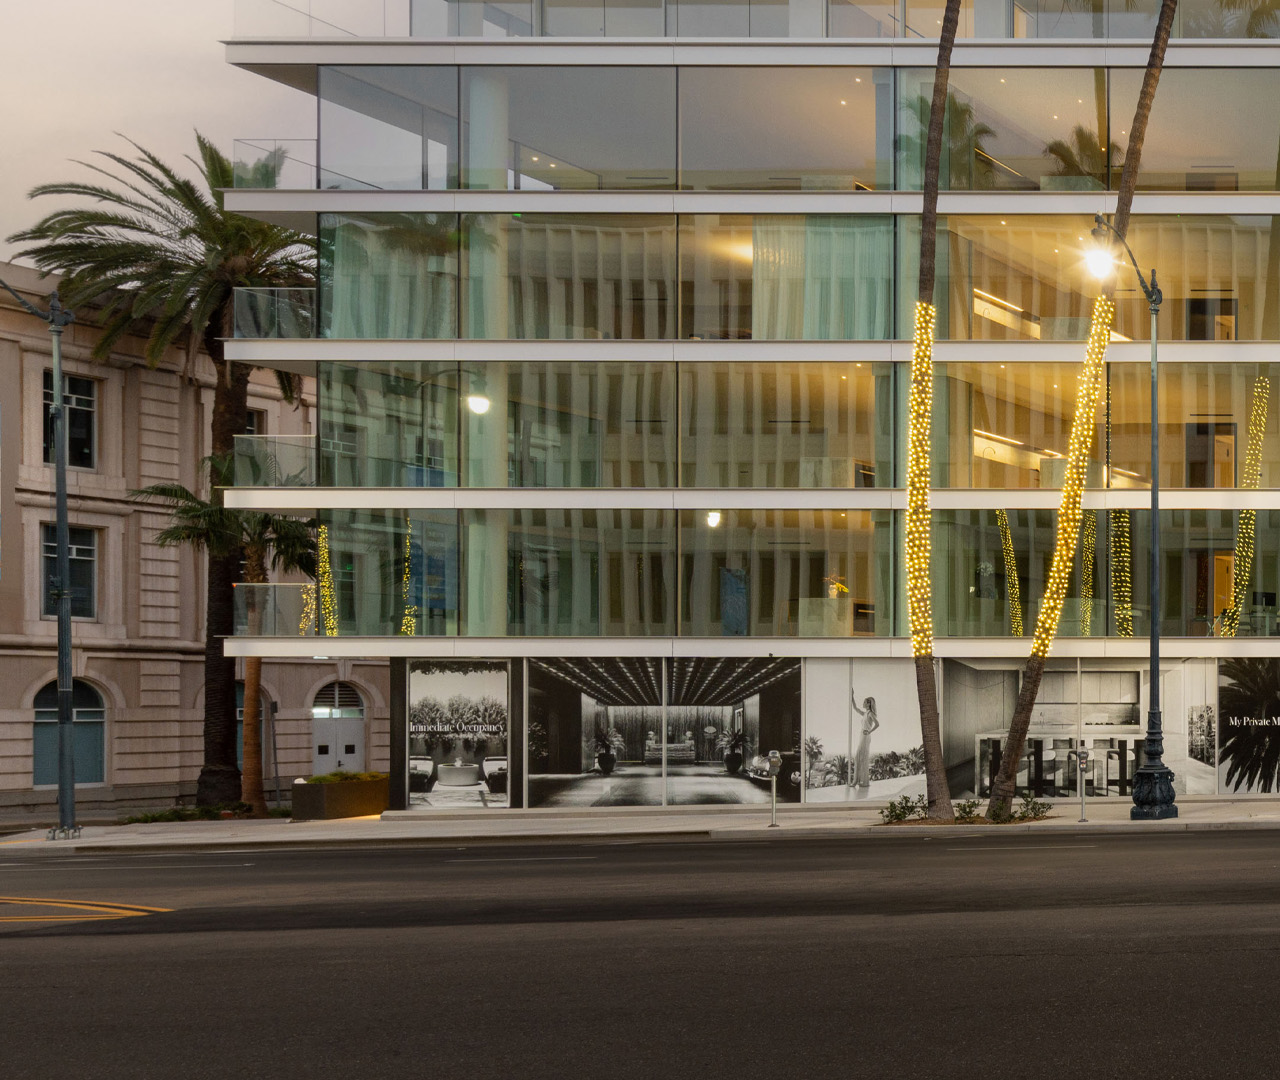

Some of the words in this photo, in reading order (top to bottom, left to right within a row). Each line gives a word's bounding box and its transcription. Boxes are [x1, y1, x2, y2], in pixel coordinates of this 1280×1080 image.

[410, 721, 455, 732] Immediate
[456, 721, 505, 734] Occupancy
[1229, 716, 1241, 727] My
[1243, 716, 1271, 726] Private
